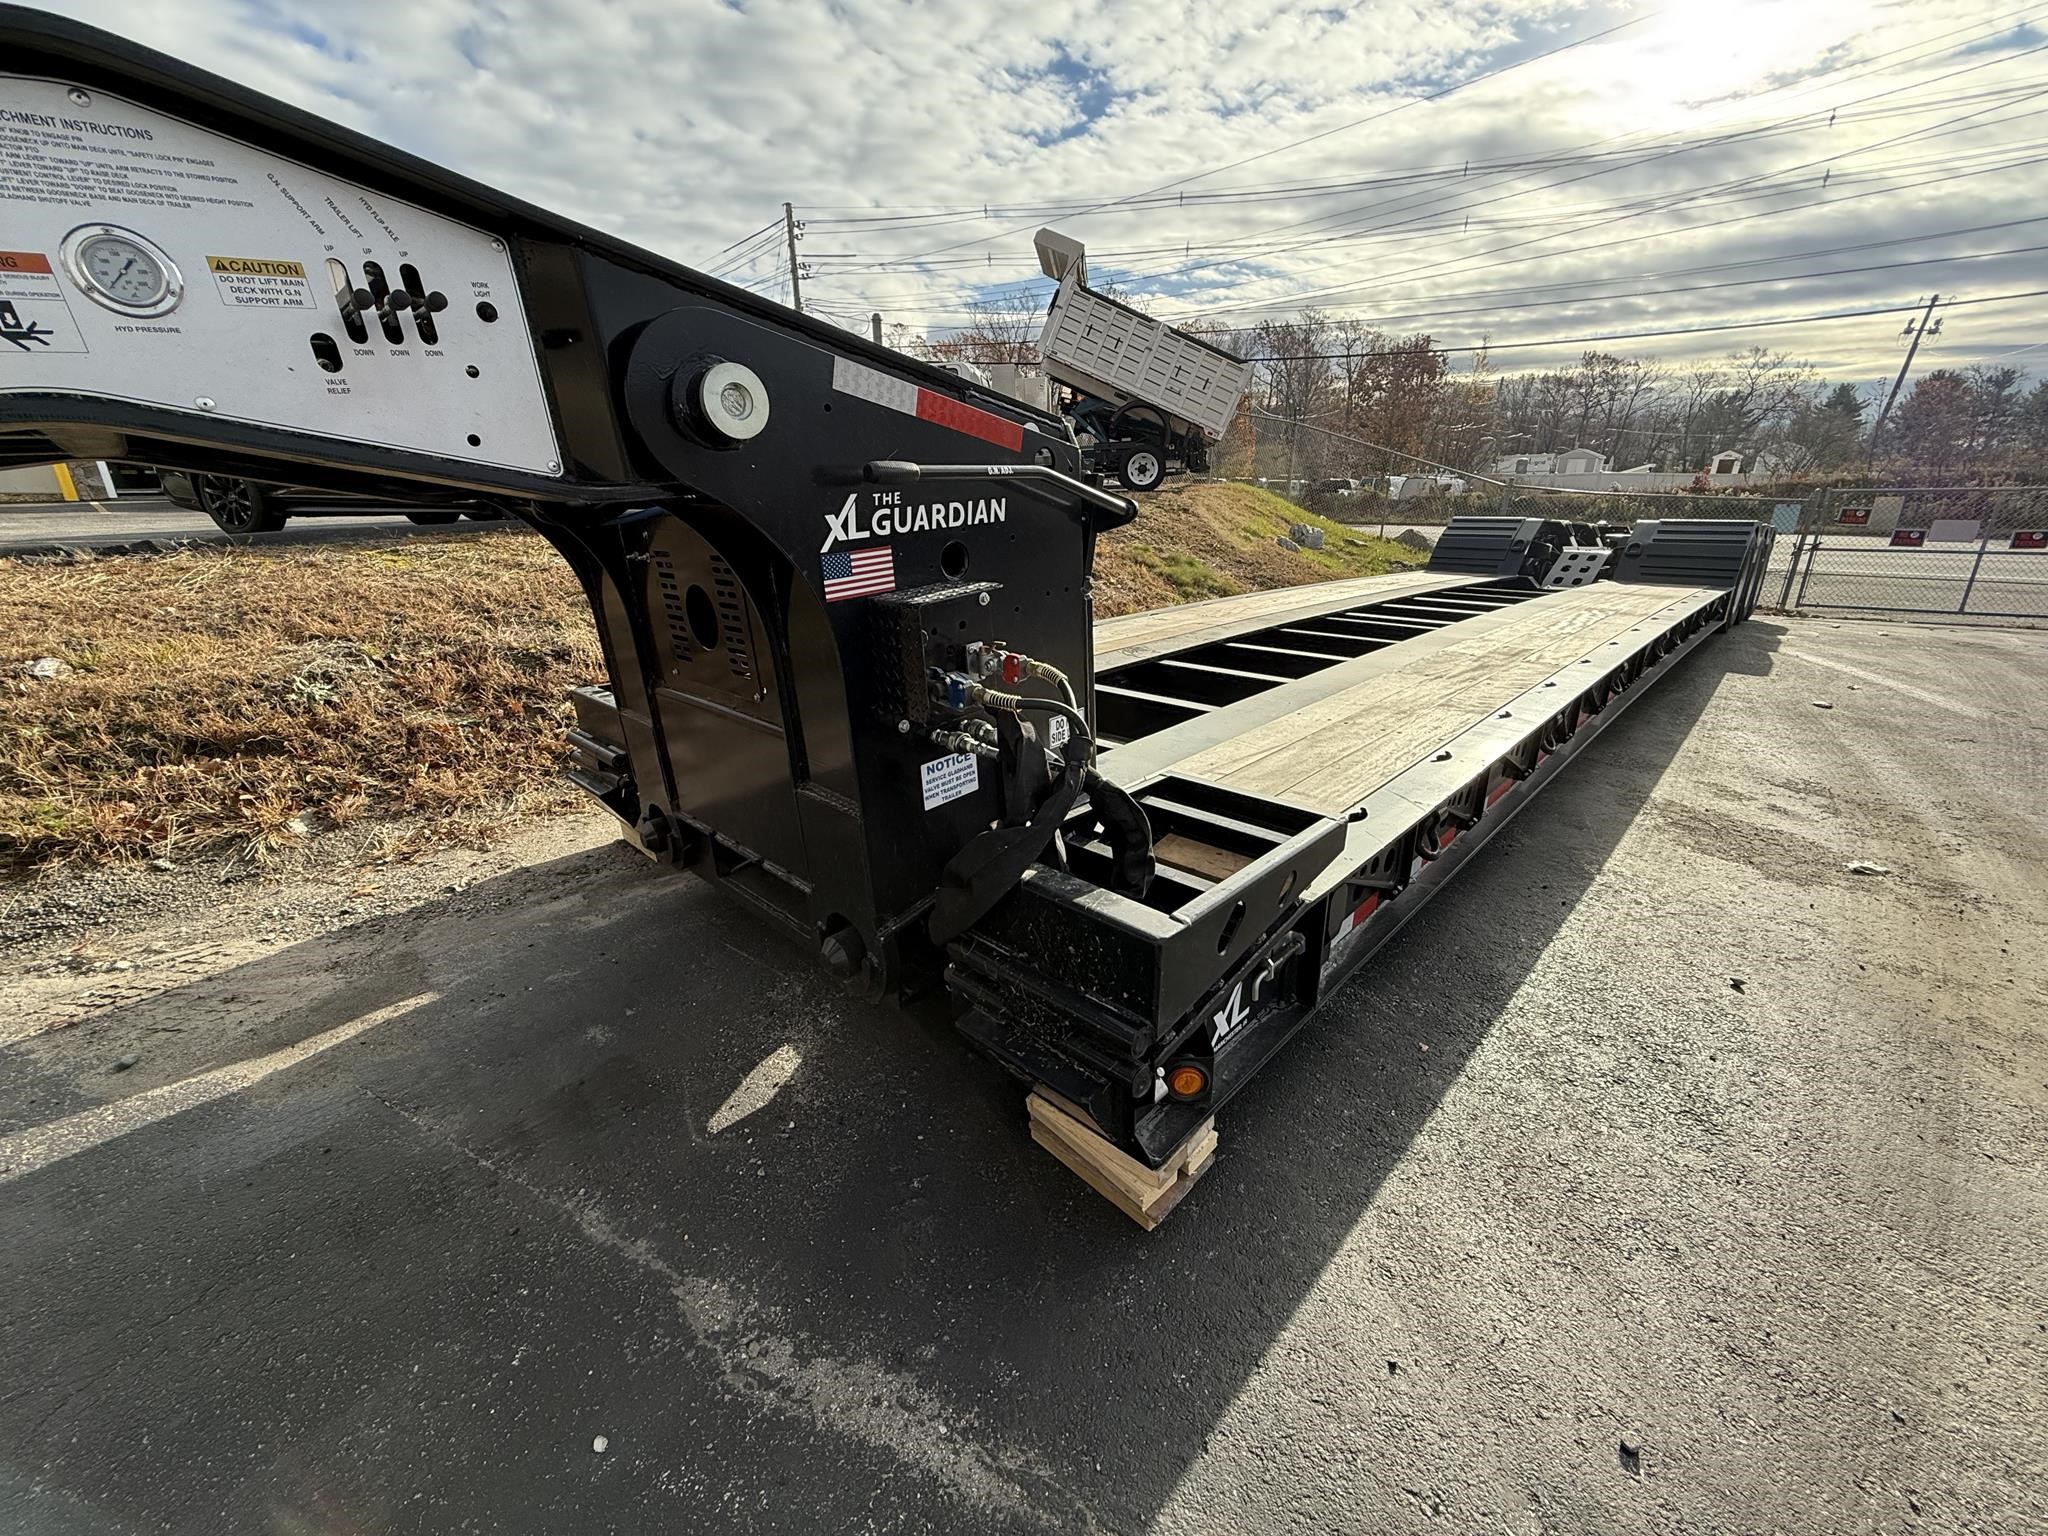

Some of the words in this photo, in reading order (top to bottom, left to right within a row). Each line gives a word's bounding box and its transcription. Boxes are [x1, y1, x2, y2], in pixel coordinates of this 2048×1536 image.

[0, 109, 57, 128] CHMENT
[59, 118, 153, 141] INSTRUCTIONS
[280, 187, 311, 219] SUPPORT
[309, 217, 325, 235] ARM
[324, 196, 350, 226] TRAILER
[348, 224, 364, 239] LIFT
[358, 196, 372, 212] HYD
[370, 210, 385, 225] FLIP
[383, 225, 400, 243] AXLE
[323, 244, 334, 252] UP
[362, 247, 373, 255] UP
[399, 250, 409, 258] UP
[229, 260, 299, 275] CAUTION
[219, 275, 234, 283] DO
[235, 275, 257, 285] NOT
[259, 277, 279, 286] LIFT
[280, 279, 304, 288] MAIN
[470, 281, 490, 289] WORK
[230, 286, 257, 295] DECK
[259, 287, 282, 296] WITH
[473, 290, 491, 298] LIGHT
[235, 296, 282, 305] SUPPORT
[283, 298, 304, 306] ARM
[115, 325, 134, 333] HYD
[135, 326, 181, 334] PRESSURE
[390, 349, 410, 357] DOWN
[424, 349, 444, 357] DOWN
[325, 378, 348, 386] VALVE
[327, 387, 351, 395] RELIEF
[872, 492, 902, 506] THE
[820, 493, 871, 553] XL
[871, 498, 1006, 536] GUARDIAN
[1051, 729, 1066, 744] SIDE
[927, 754, 971, 776] NOTICE
[926, 774, 946, 785] SERVICE
[948, 764, 973, 776] GLADHAND
[924, 784, 940, 793] VALVE
[941, 778, 954, 787] MUST
[963, 770, 975, 778] OPEN
[925, 792, 939, 800] WHEN
[940, 777, 976, 794] TRANSPORTING
[942, 790, 962, 801] TRAILER
[1211, 980, 1250, 1048] XL
